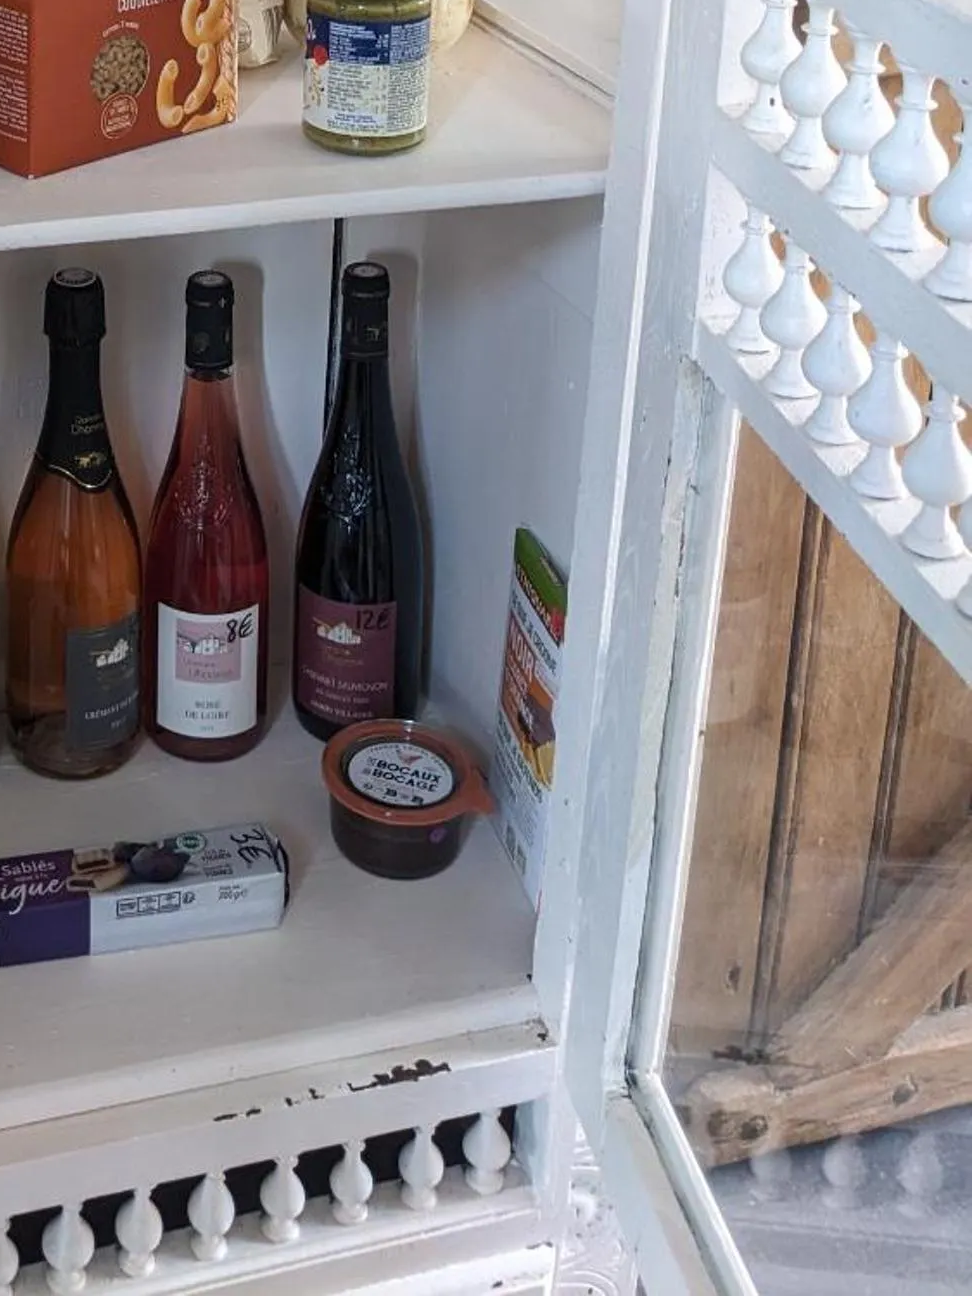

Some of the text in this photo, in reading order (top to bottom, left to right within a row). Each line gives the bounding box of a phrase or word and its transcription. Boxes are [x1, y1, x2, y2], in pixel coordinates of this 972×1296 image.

[225, 612, 255, 644] 8€
[355, 608, 391, 631] 12€
[371, 768, 439, 793] BOCAGE
[376, 759, 443, 784] BOCAUX
[0, 859, 57, 878] Sablés
